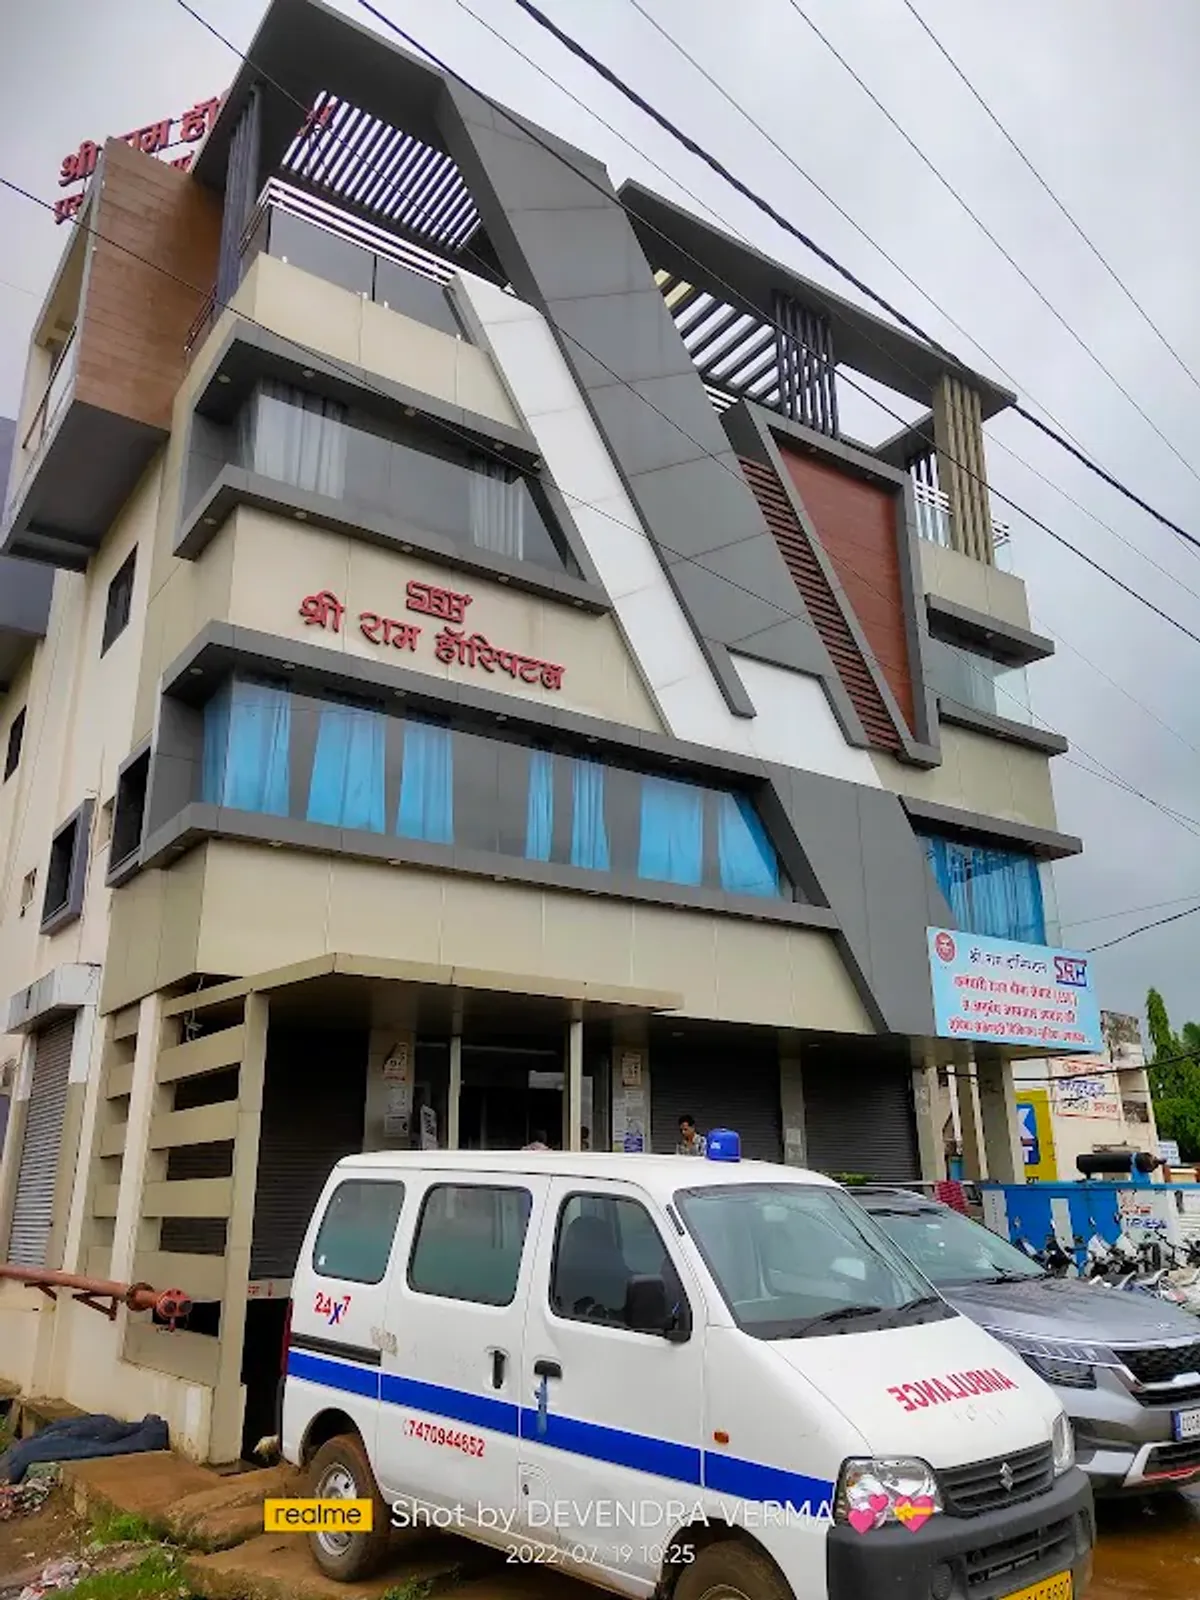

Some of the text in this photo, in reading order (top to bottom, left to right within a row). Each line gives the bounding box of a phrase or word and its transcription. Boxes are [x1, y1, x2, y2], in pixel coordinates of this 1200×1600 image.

[58, 140, 98, 187] श्री
[299, 590, 565, 690] श्री राम हॉस्पिटल
[1054, 956, 1087, 987] SRH
